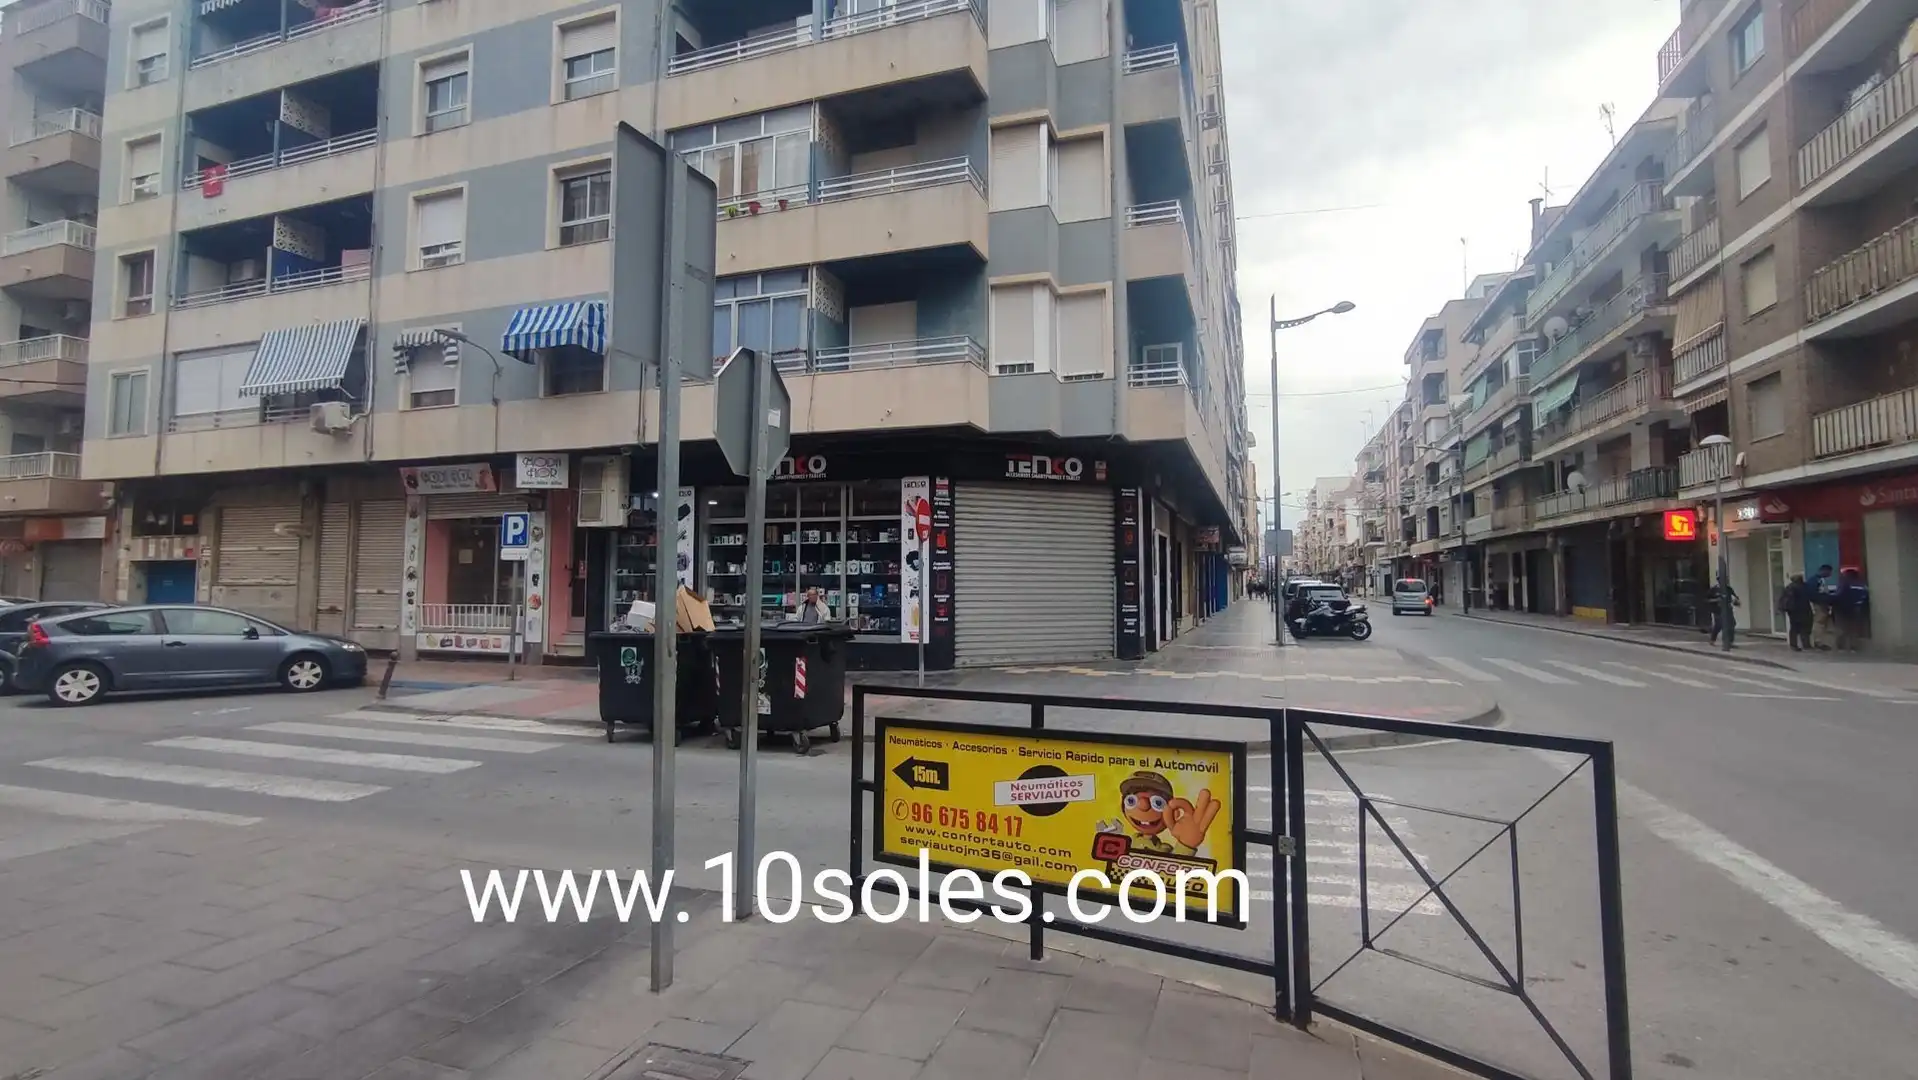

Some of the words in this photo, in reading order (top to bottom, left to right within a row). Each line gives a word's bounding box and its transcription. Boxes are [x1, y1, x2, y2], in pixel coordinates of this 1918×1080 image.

[507, 516, 524, 544] P
[889, 735, 943, 749] Neumáticos
[952, 741, 1008, 755] Accesorios
[1018, 746, 1062, 760] Servicio
[1108, 753, 1135, 766] para
[1139, 756, 1149, 768] el
[1154, 757, 1219, 774] Automóvil
[912, 765, 941, 785] 15m.
[1010, 779, 1084, 792] Neumáticos
[1010, 788, 1081, 801] SERVIAUTO
[911, 802, 933, 824] 96
[938, 806, 970, 830] 675
[976, 811, 999, 835] 84
[1004, 815, 1023, 838] 17
[905, 824, 1072, 858] www.confortauto.com
